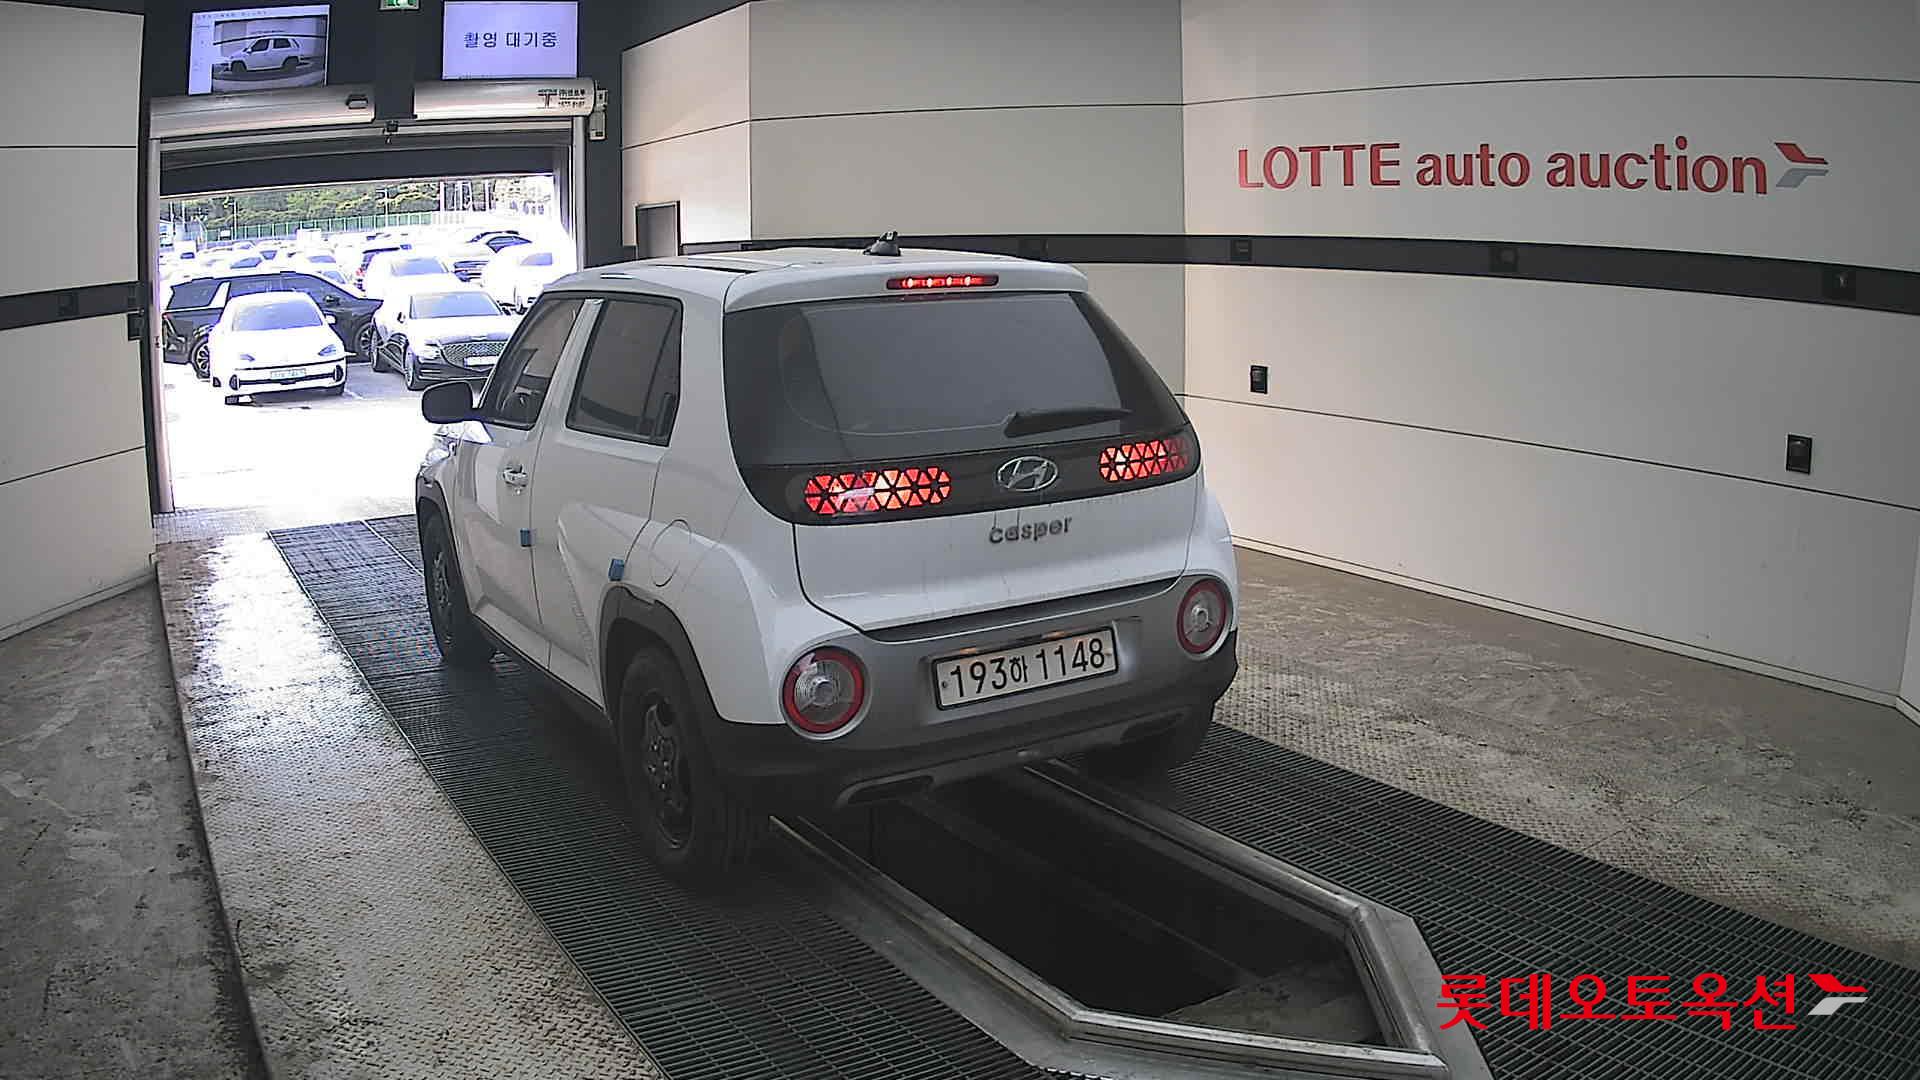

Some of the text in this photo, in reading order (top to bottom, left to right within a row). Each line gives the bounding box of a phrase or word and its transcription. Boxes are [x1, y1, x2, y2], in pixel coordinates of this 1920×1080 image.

[463, 31, 557, 48] 촬영 대기중
[1238, 135, 1768, 195] LOTTE auto auction
[989, 516, 1072, 544] casper
[950, 638, 1105, 698] 193하 1148
